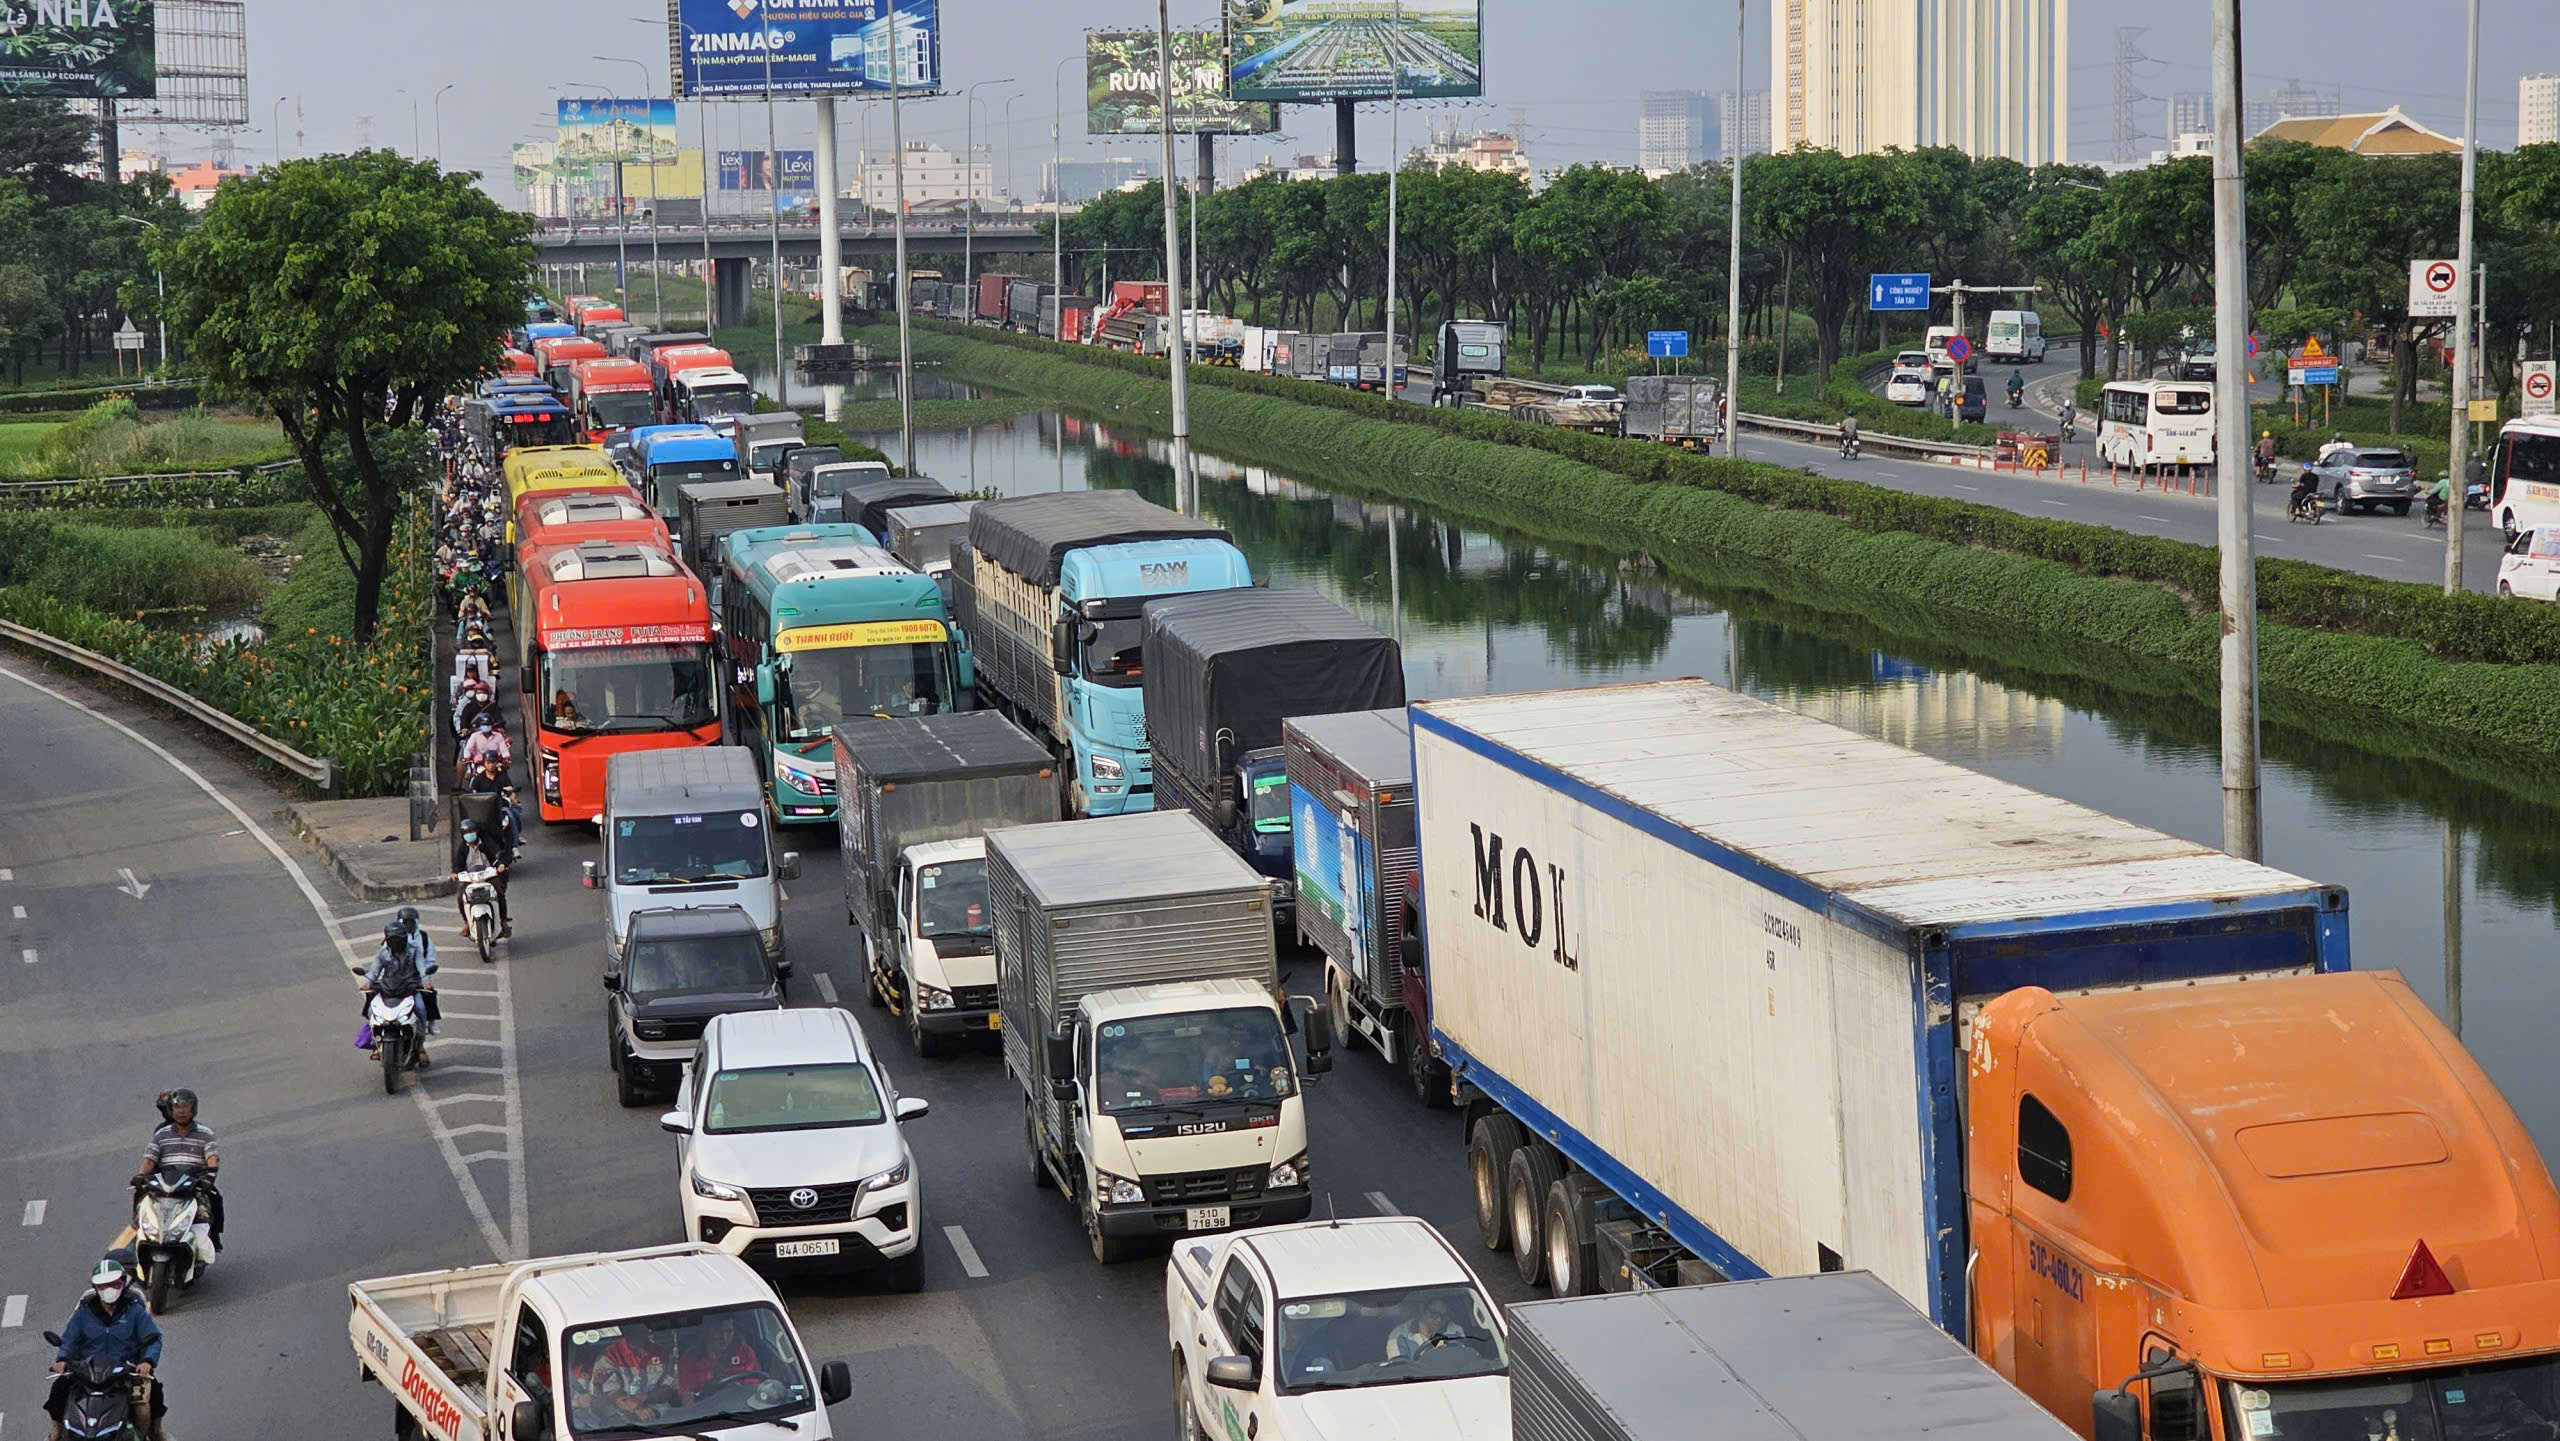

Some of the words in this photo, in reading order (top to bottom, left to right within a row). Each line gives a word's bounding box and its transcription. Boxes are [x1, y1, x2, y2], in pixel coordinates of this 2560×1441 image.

[6, 8, 27, 25] Là
[849, 11, 864, 19] GIA
[1305, 12, 1324, 20] NAM
[747, 55, 764, 64] KIM
[1109, 68, 1163, 91] RỪN
[784, 155, 812, 173] Léxi
[2531, 363, 2548, 372] ZONE
[1139, 560, 1187, 577] FAW
[550, 629, 588, 642] PHƯƠNG
[590, 627, 623, 639] TRANG
[631, 626, 661, 637] FUTA
[901, 623, 918, 633] 1900
[567, 640, 581, 648] XE
[660, 635, 680, 643] LONG
[1177, 1121, 1227, 1135] ISUZU
[1199, 1208, 1218, 1219] 51D
[2029, 1239, 2085, 1305] 51C-460.21
